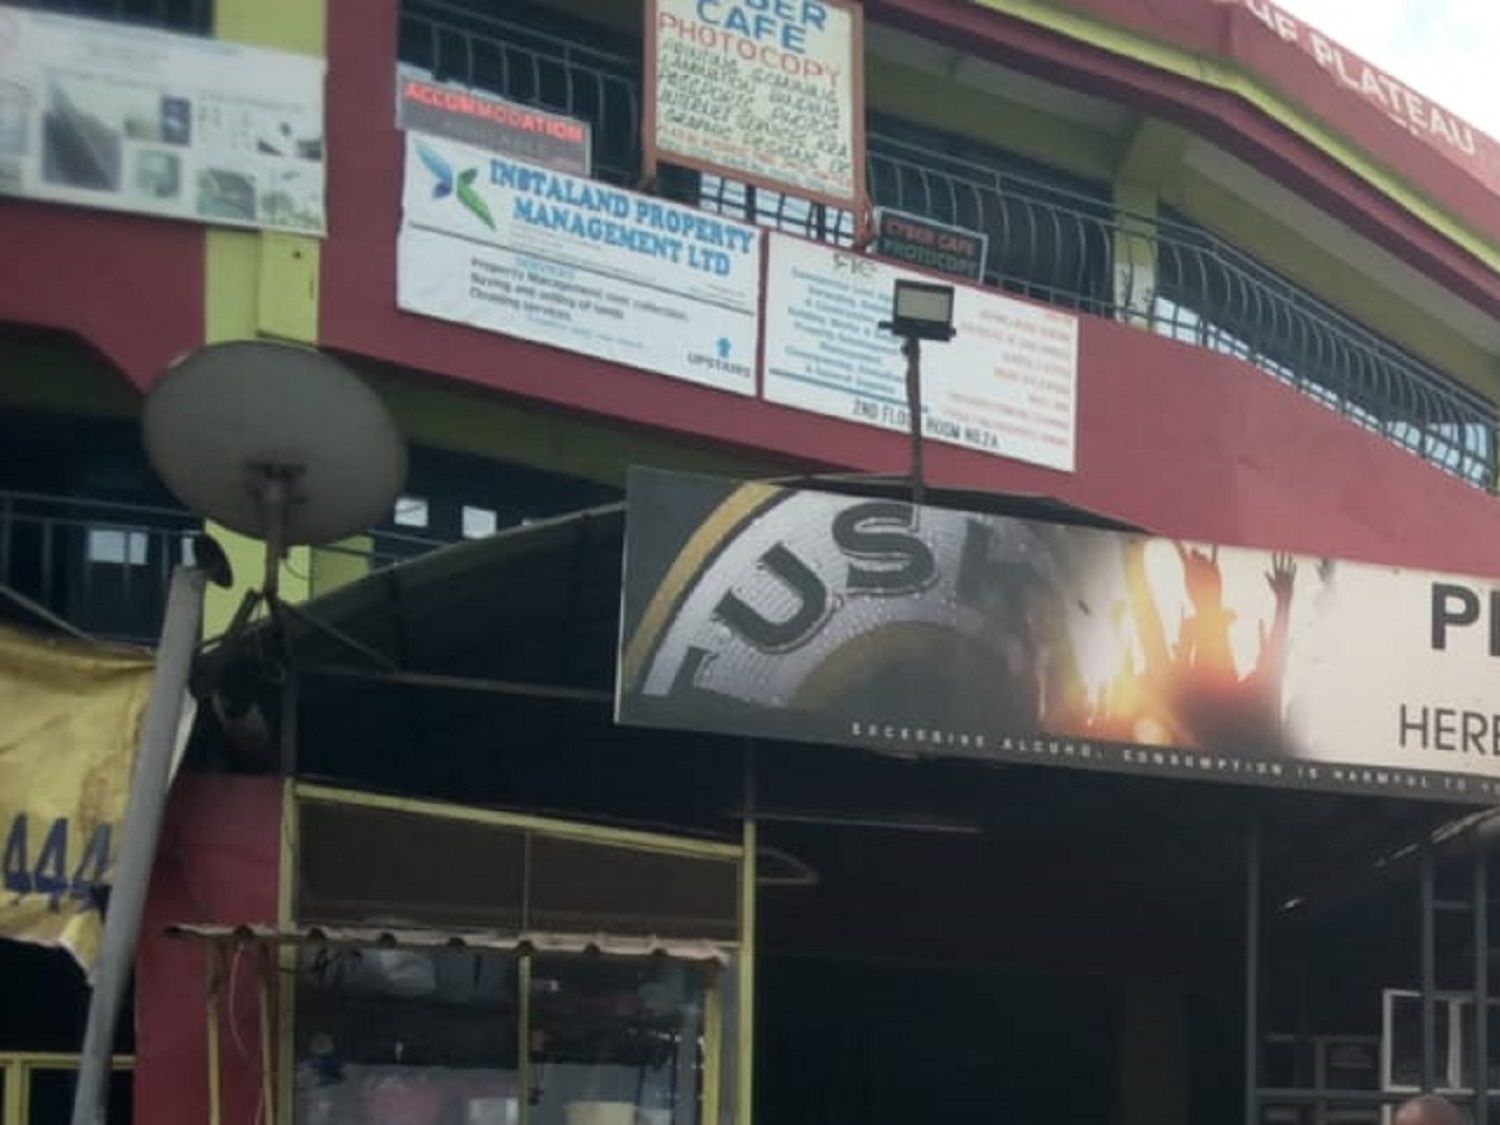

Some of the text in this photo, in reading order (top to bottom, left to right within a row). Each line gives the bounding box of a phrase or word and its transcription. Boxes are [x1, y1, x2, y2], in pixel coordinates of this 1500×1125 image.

[659, 12, 840, 88] PHOTOCOPY
[696, 0, 807, 54] CAFE
[405, 82, 583, 143] ACCOMMODATION
[1310, 34, 1476, 155] PLATEAU
[489, 159, 631, 220] INSTALAND
[636, 201, 755, 254] PROPERTY
[513, 196, 683, 264] MANAGEMENT
[688, 246, 732, 277] LTD
[686, 351, 751, 378] UPSTAIRS
[881, 404, 919, 430] FLO
